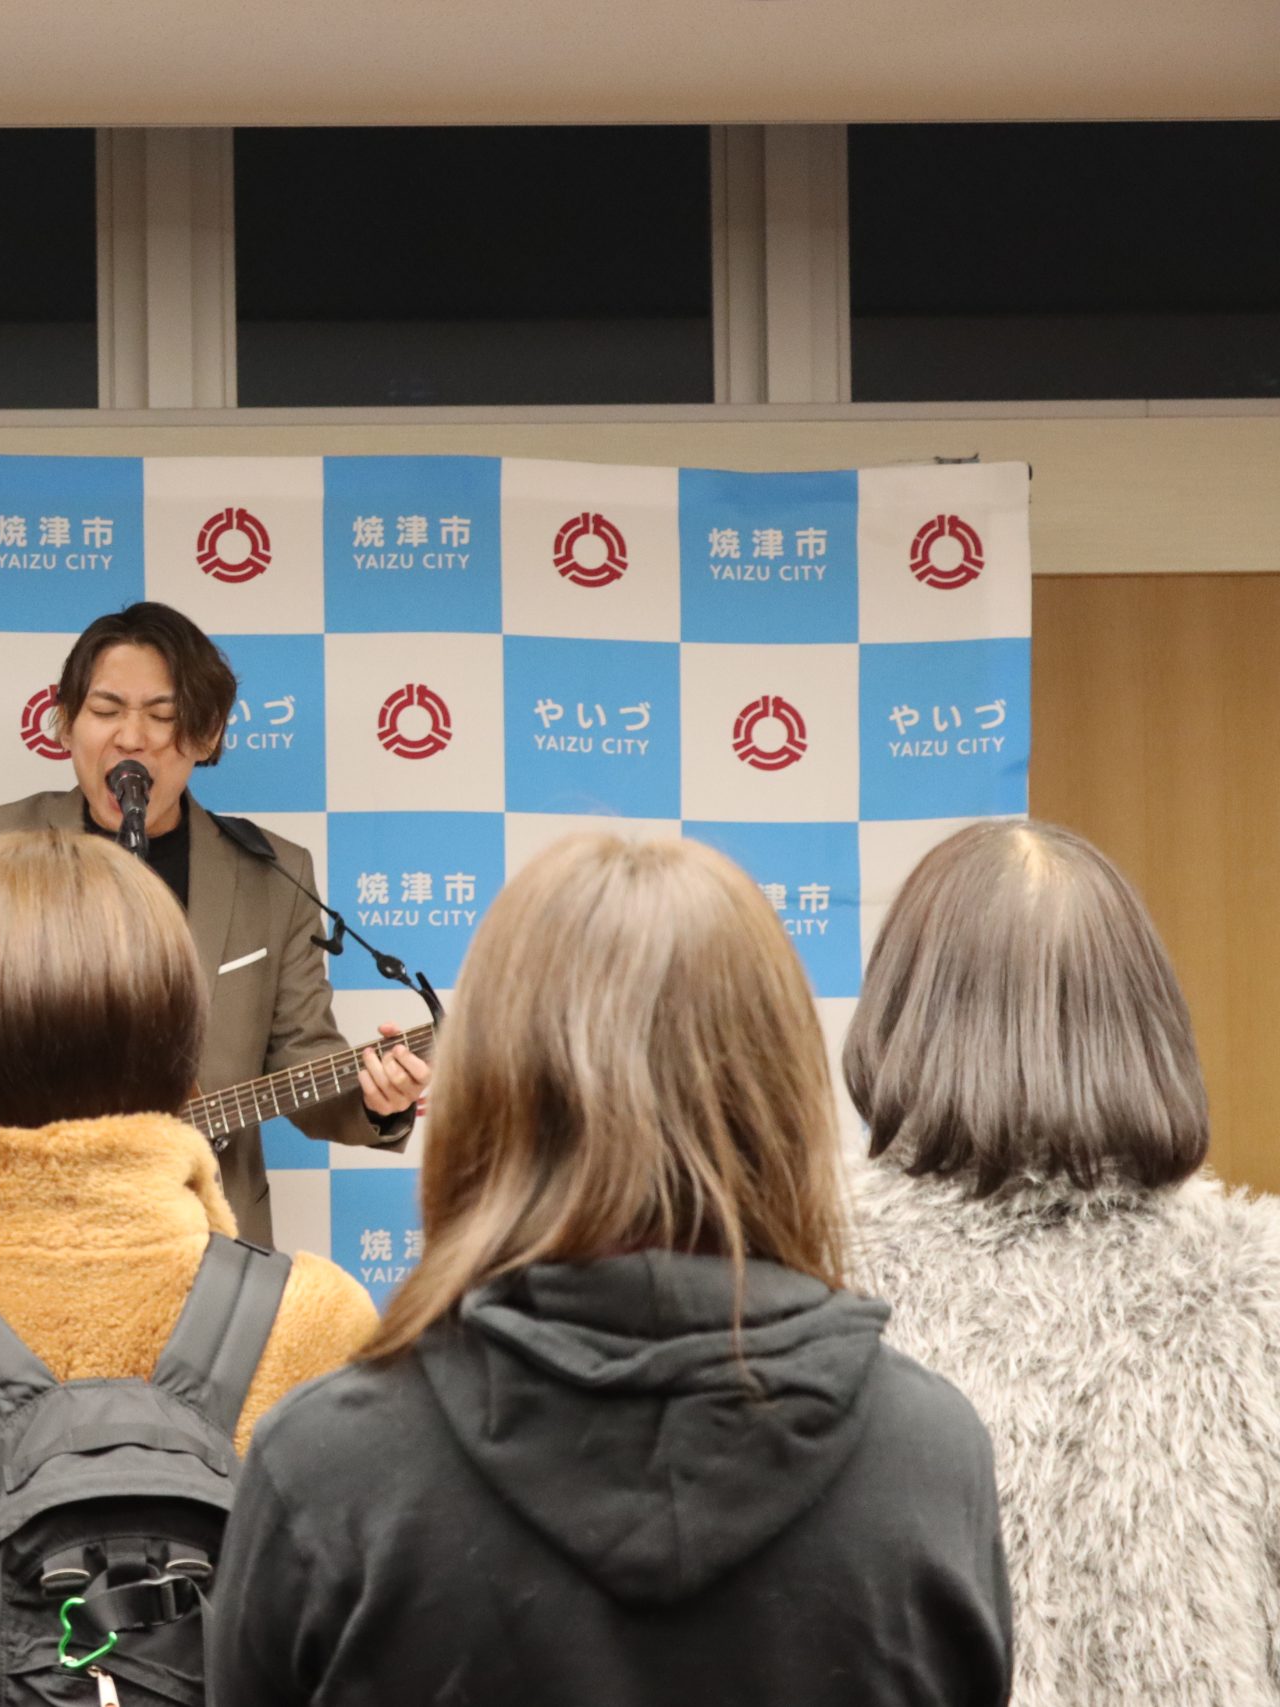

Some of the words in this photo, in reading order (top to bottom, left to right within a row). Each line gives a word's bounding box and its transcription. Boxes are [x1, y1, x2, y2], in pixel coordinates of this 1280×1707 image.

[351, 513, 473, 550] 焼津市
[707, 527, 830, 561] 焼津市
[64, 551, 113, 572] CITY
[351, 551, 415, 572] YAIZU
[421, 551, 471, 570] CITY
[709, 563, 773, 582] YAIZU
[778, 563, 826, 583] CITY
[226, 694, 296, 726] いづ
[533, 697, 651, 732] やいづ
[887, 699, 1006, 736] やいづ
[246, 732, 295, 750] CITY
[534, 735, 594, 753] YAIZU
[601, 736, 649, 755] CITY
[889, 738, 950, 757] YAIZU
[955, 736, 1004, 756] CITY
[355, 871, 477, 906] 焼津市
[357, 908, 420, 928] YAIZU
[428, 909, 479, 929] CITY
[783, 918, 829, 936] CITY
[359, 1266, 411, 1284] YAIZ
